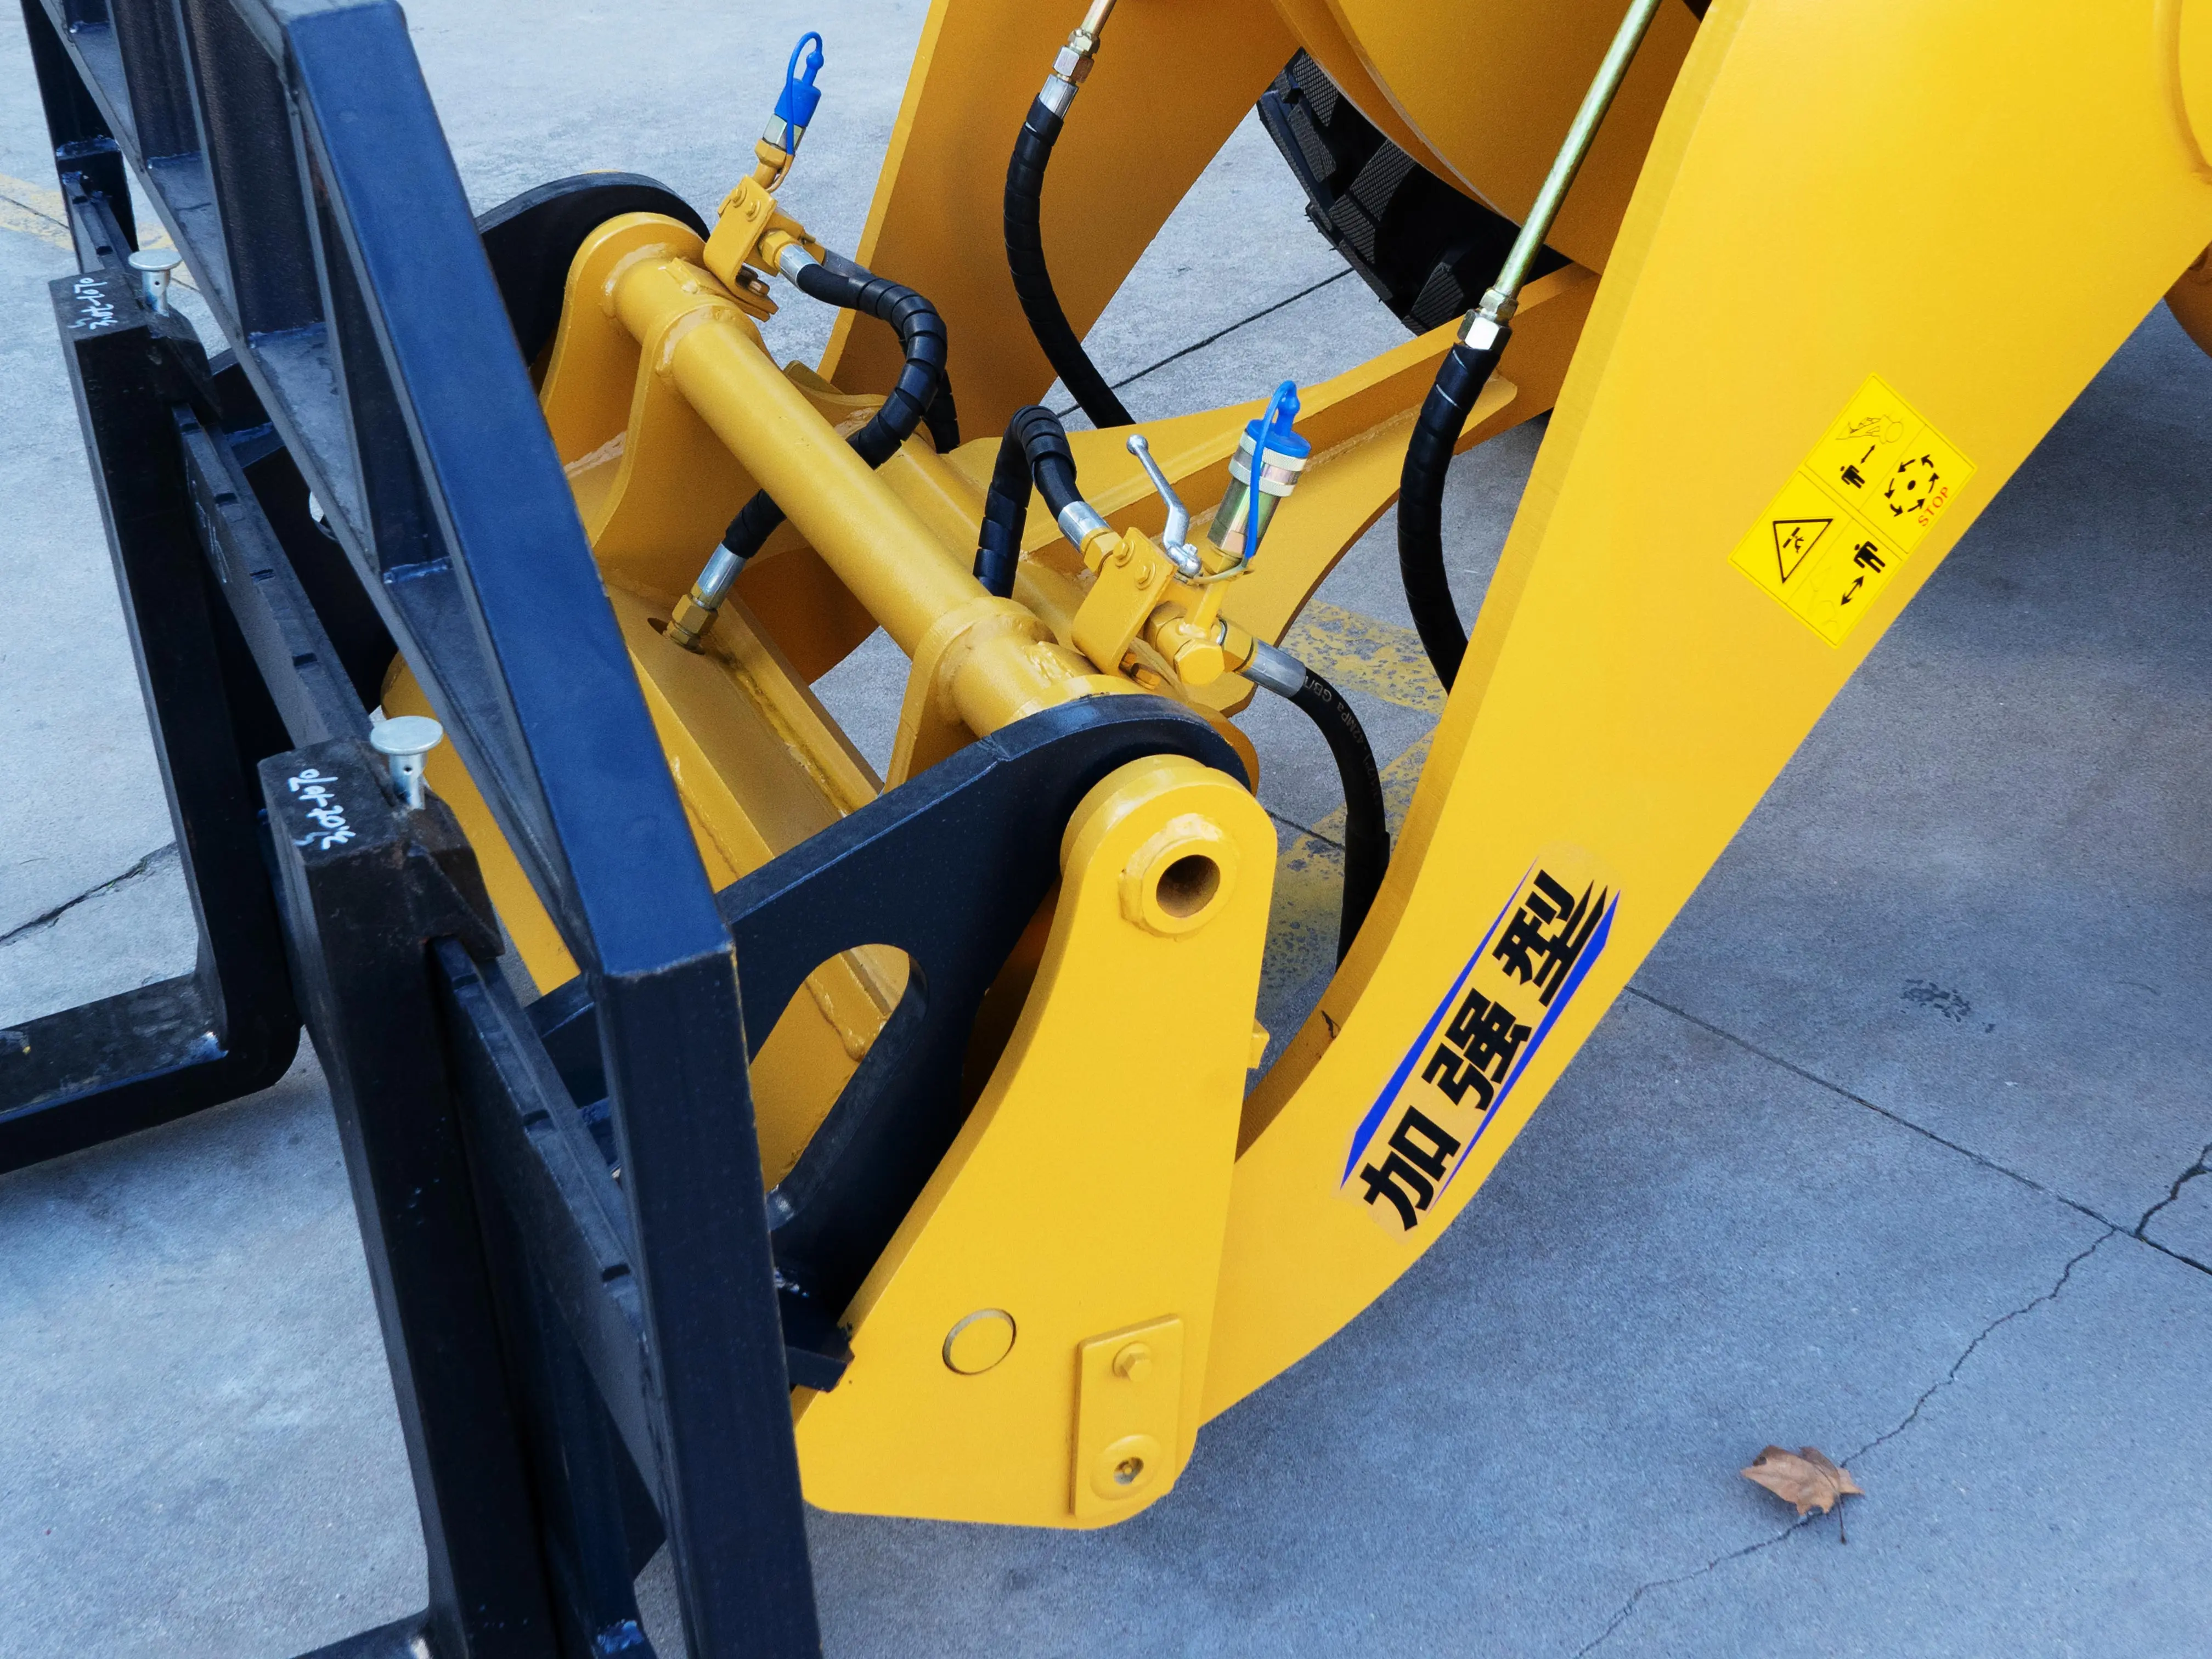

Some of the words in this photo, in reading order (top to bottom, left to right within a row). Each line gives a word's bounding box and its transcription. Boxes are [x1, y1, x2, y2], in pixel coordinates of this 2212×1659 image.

[1917, 487, 1948, 527] STOP
[1336, 702, 1364, 744] 42MPa
[1359, 868, 1608, 1232] 加强型
